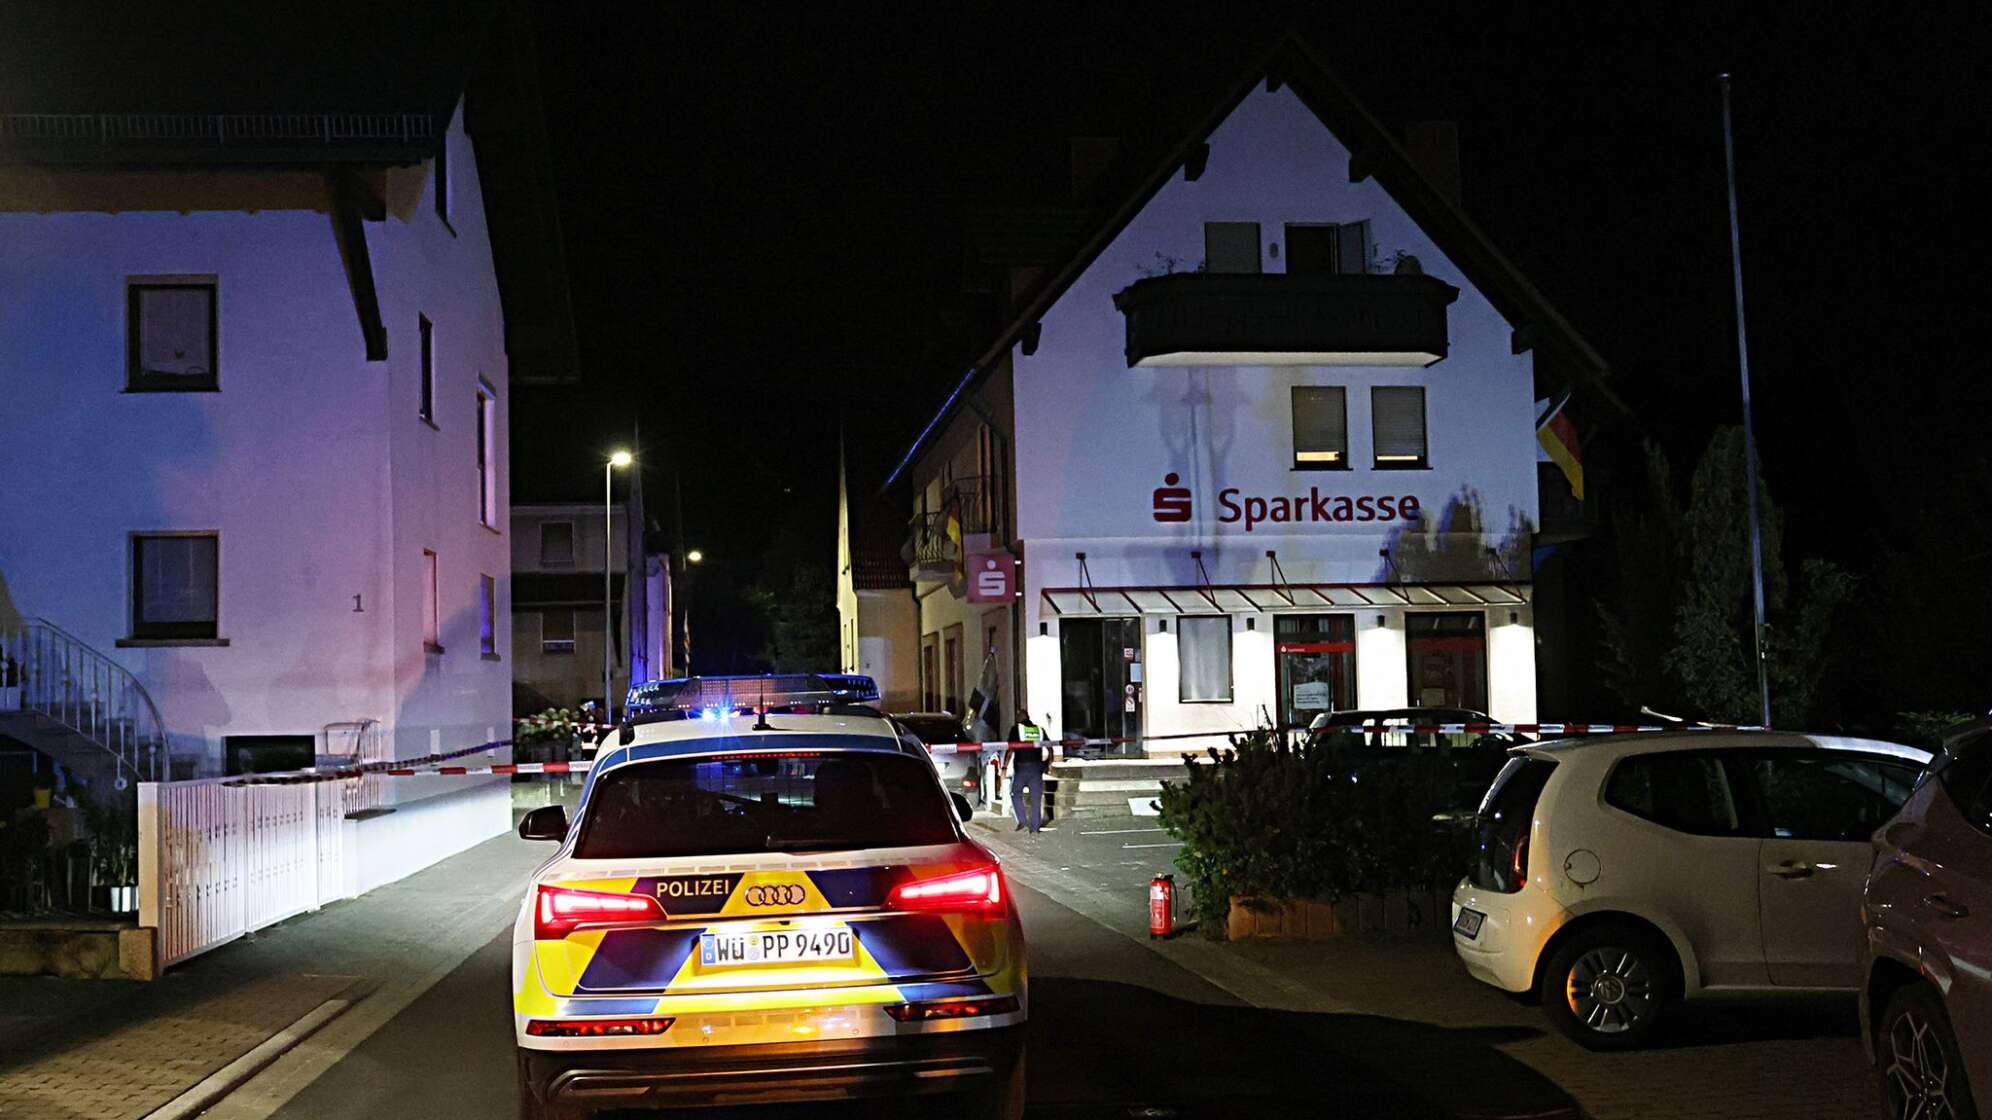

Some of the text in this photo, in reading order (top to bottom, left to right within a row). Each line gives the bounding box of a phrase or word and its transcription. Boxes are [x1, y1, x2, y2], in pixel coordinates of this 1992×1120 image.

[1218, 487, 1420, 531] Sparkasse
[352, 593, 364, 612] 1
[656, 879, 729, 898] POLIZEI
[716, 938, 745, 961] WÜ
[762, 935, 789, 959] PP
[796, 931, 850, 957] 9490
